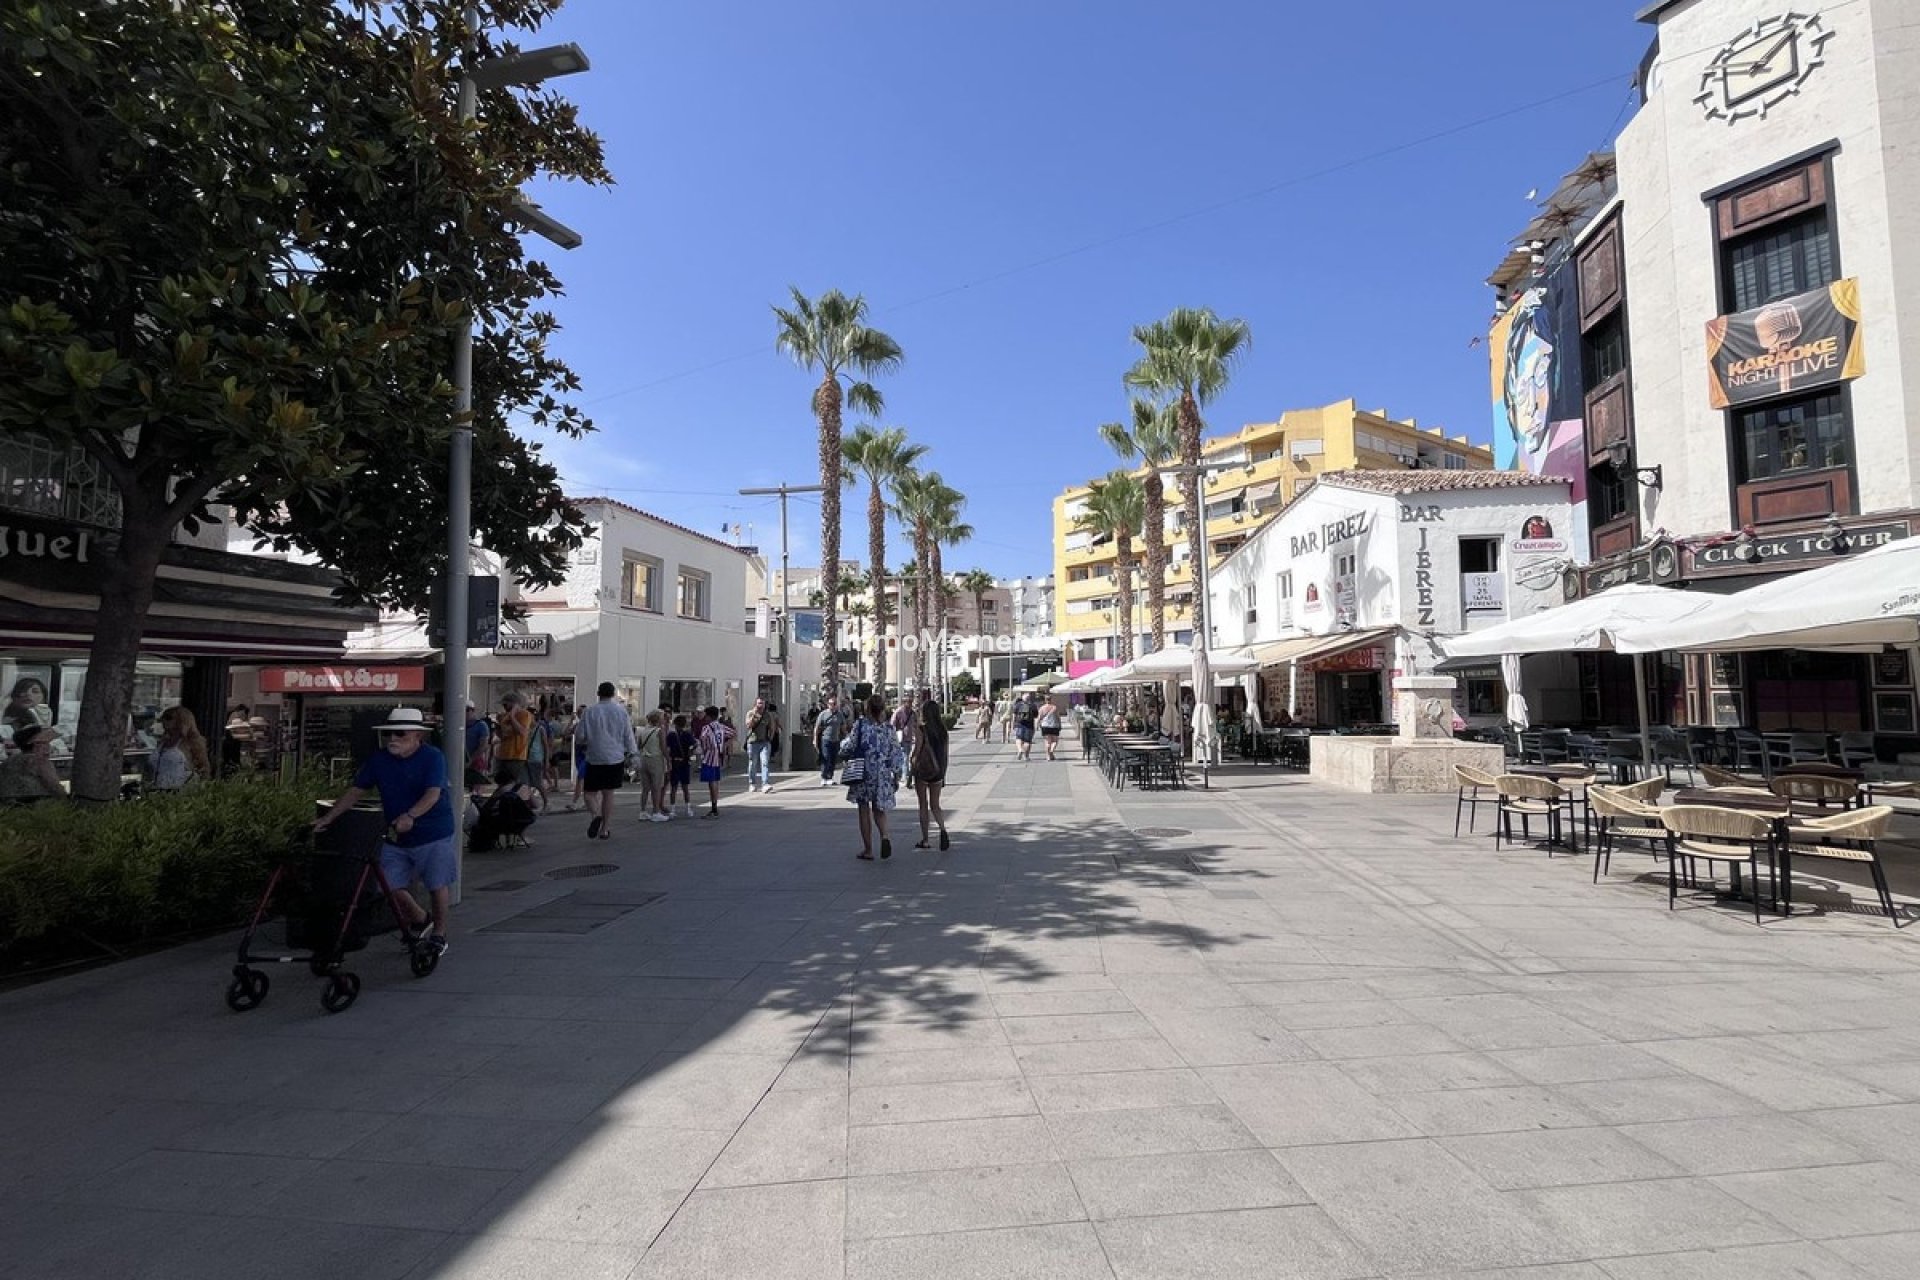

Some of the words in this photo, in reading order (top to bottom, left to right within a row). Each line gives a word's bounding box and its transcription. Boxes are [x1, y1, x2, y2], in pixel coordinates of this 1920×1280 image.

[1728, 336, 1838, 377] KARAOKE
[1728, 367, 1777, 388] NIGHT
[1791, 353, 1839, 377] LIVE
[1400, 505, 1444, 522] BAR
[1290, 532, 1319, 558] BAR
[1321, 510, 1369, 554] JEREZ
[1704, 542, 1788, 563] CLCK
[1797, 532, 1892, 553] TOWER
[1415, 527, 1436, 626] JEREZ
